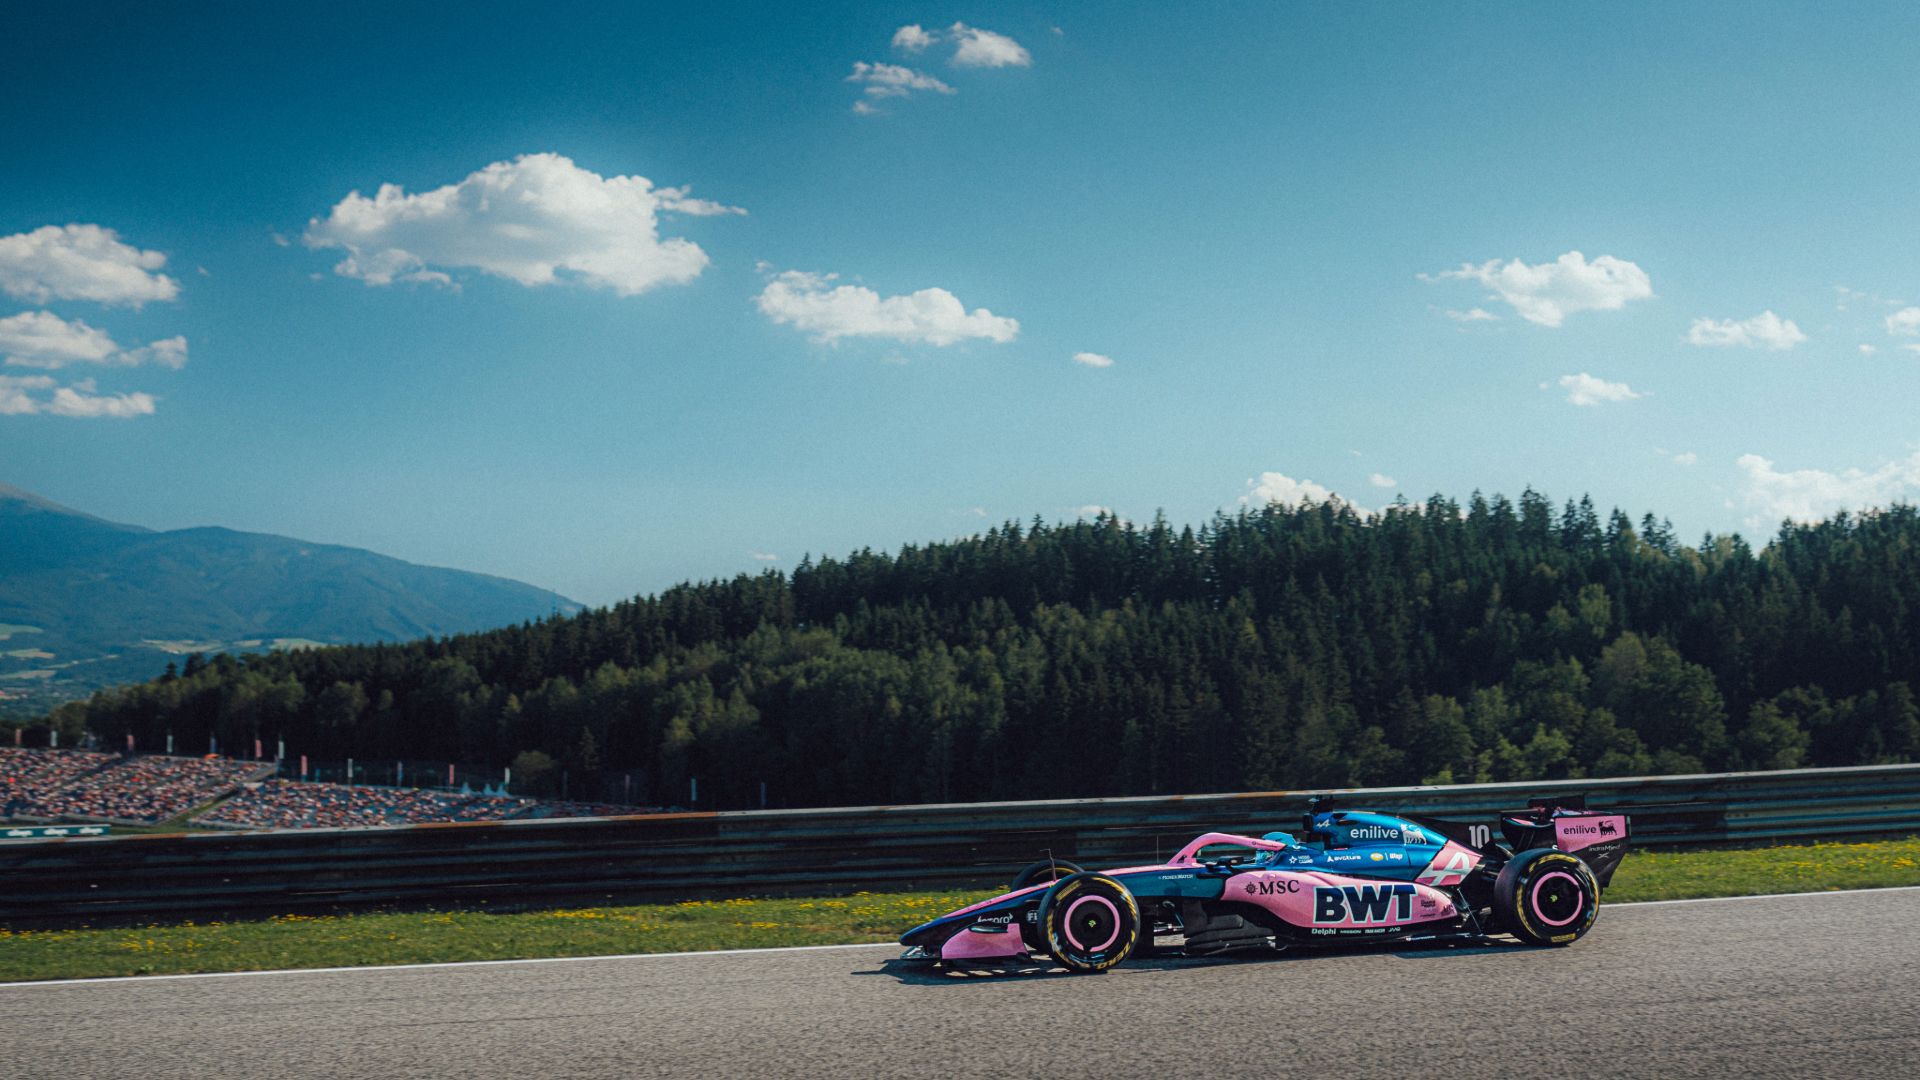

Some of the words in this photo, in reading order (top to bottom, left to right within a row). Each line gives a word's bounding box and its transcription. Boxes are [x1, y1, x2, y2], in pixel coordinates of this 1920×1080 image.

[1350, 826, 1399, 839] enilive
[1468, 825, 1490, 849] 10
[1563, 825, 1597, 835] enilive
[1259, 880, 1300, 895] MSC
[1313, 883, 1418, 924] BWT
